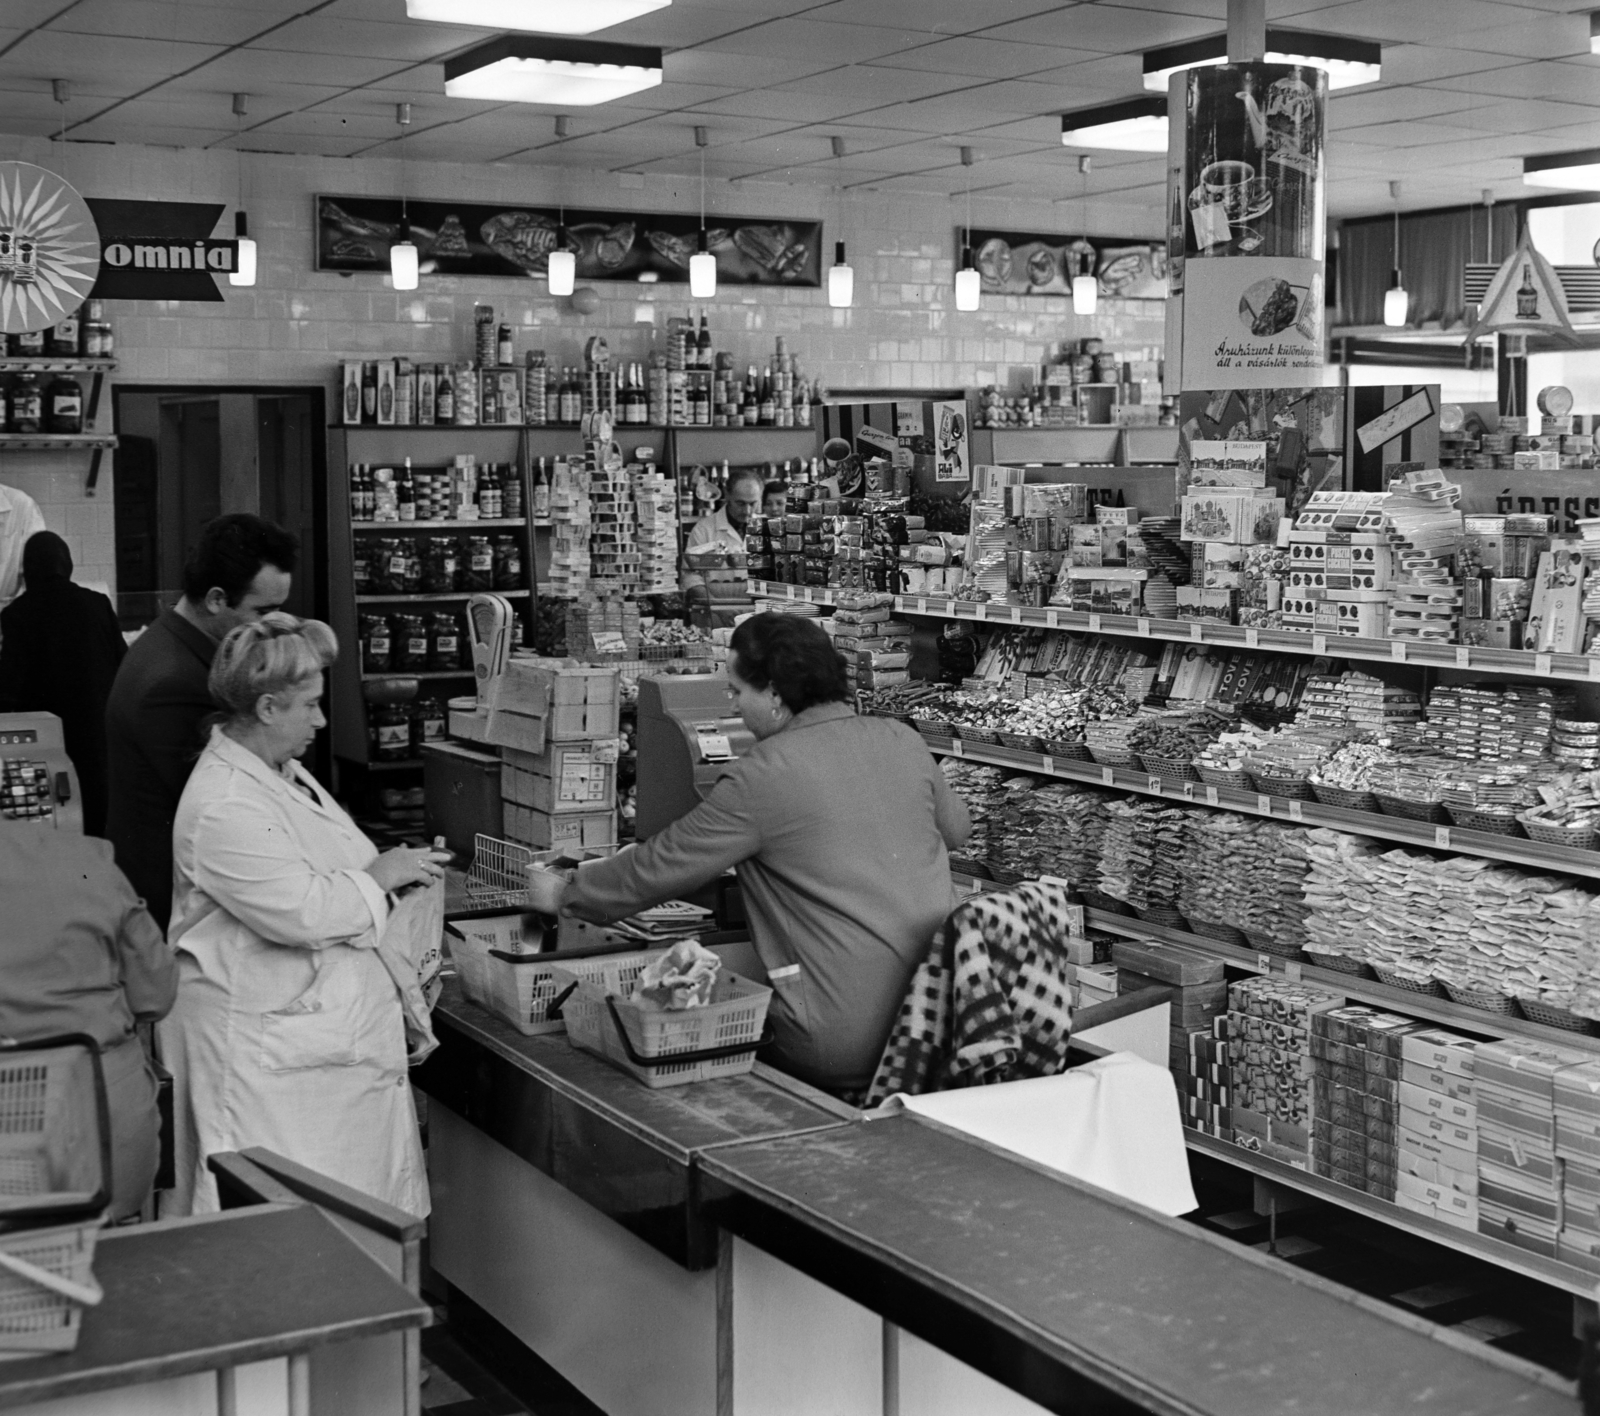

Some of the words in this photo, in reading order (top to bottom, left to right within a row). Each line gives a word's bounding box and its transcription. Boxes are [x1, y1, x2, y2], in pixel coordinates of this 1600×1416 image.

[103, 240, 233, 271] omnia
[1214, 336, 1275, 357] Áruházunk
[1216, 356, 1232, 368] áll
[1235, 360, 1242, 368] a
[1247, 356, 1288, 368] vásárlók
[1086, 488, 1126, 518] TEA
[1218, 653, 1242, 694] TOVE
[1232, 657, 1256, 699] TOVE
